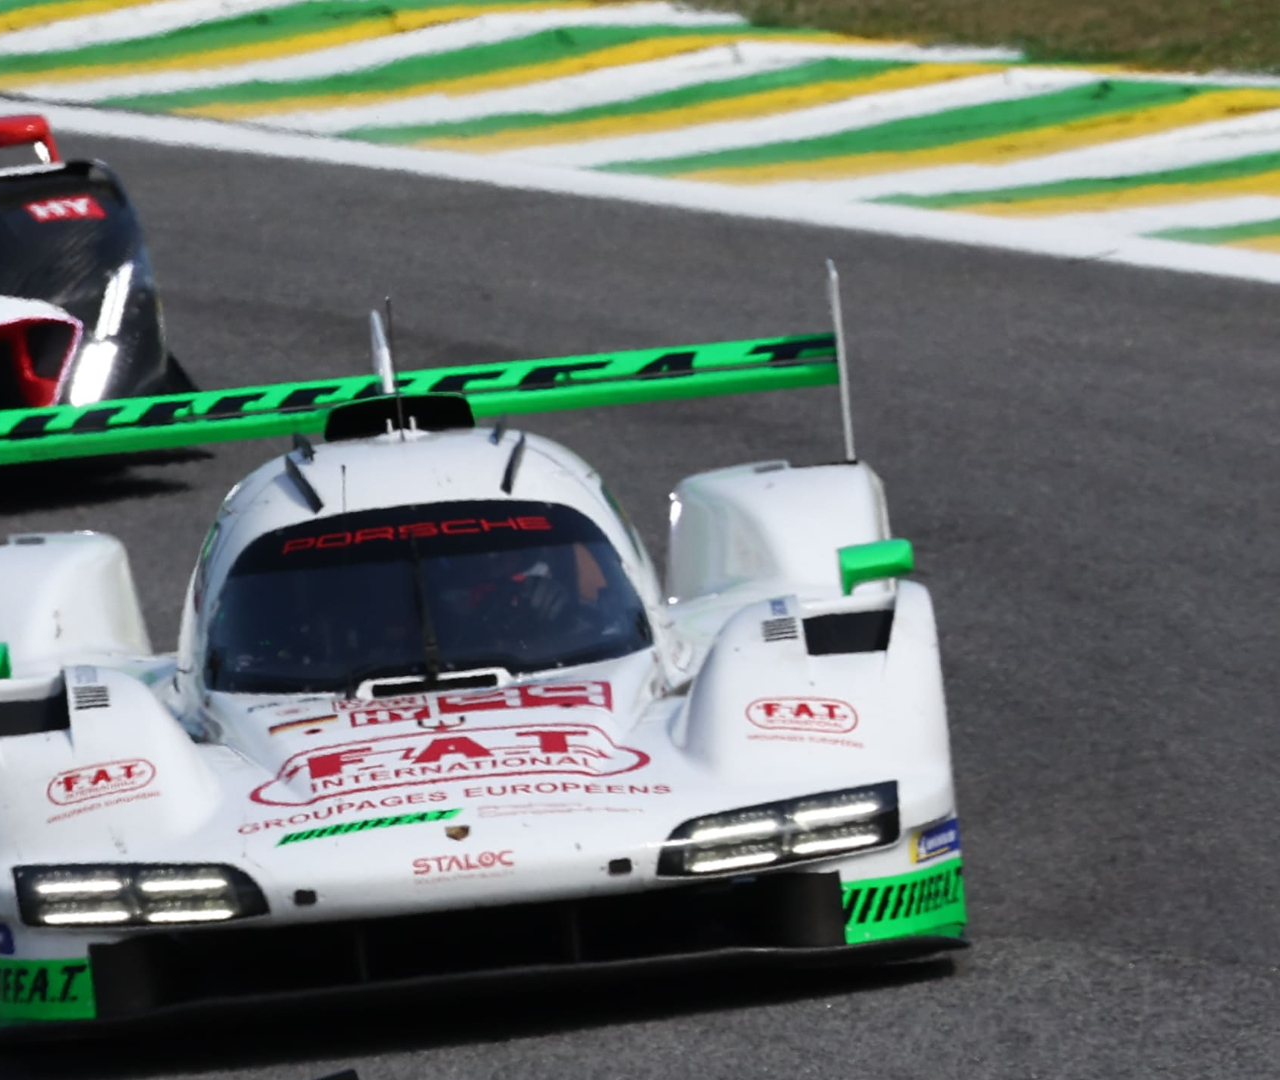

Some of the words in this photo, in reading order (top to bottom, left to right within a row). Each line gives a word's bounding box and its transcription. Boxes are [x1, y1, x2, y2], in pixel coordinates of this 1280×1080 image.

[30, 198, 89, 218] HY
[282, 516, 552, 554] PORSCHE
[357, 708, 426, 725] HY
[311, 755, 592, 792] INTERNATIONAL
[237, 790, 449, 835] GROUPAGES
[412, 850, 515, 876] STALOC
